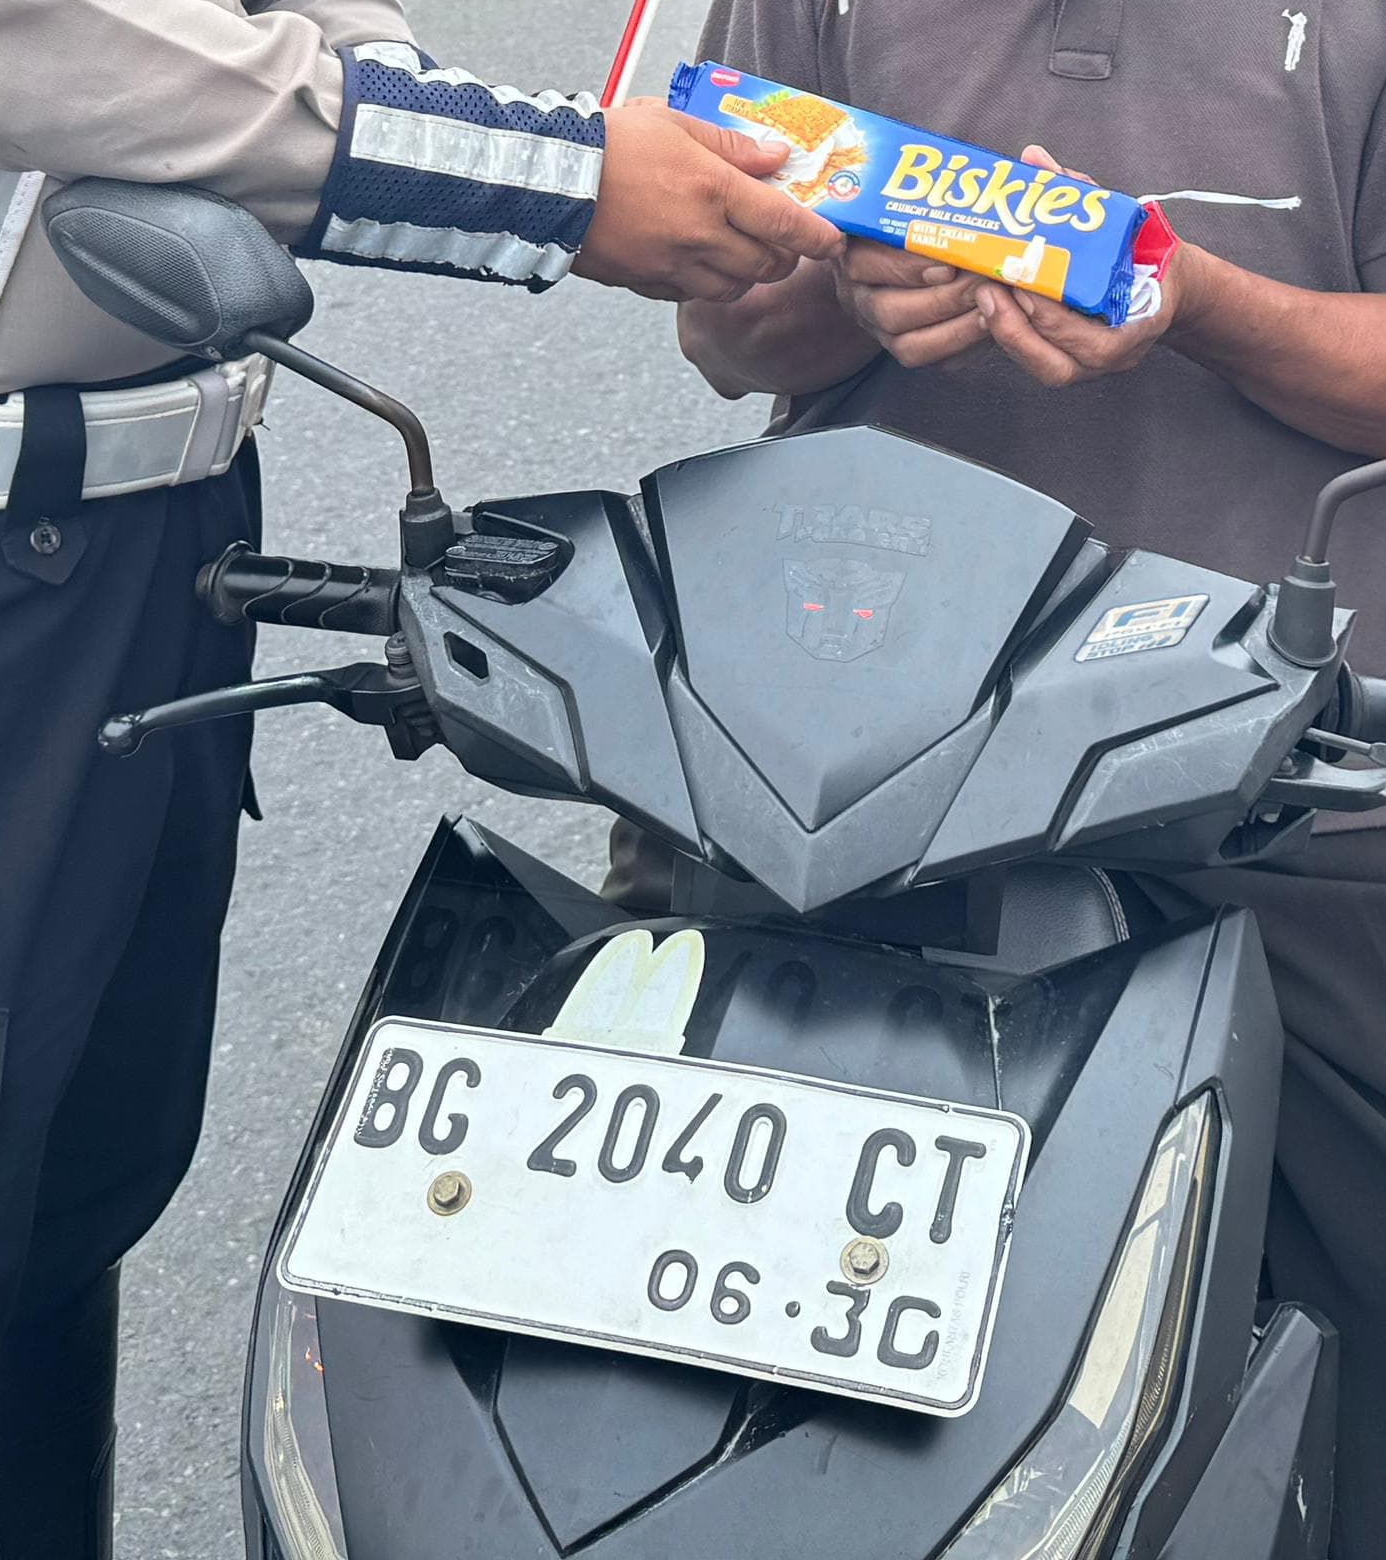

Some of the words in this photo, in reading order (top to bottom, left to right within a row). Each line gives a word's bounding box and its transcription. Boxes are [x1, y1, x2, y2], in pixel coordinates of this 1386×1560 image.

[880, 143, 1111, 235] Biskies
[885, 201, 929, 217] CRUNCHY
[929, 207, 951, 222] MILK
[951, 212, 1002, 231] CRACKERS
[1113, 600, 1192, 628] FI
[1087, 644, 1135, 658] STOP
[1090, 633, 1154, 651] IDLING
[354, 1047, 482, 1156] BG
[527, 1073, 788, 1204] 2040
[845, 1127, 986, 1244] CT
